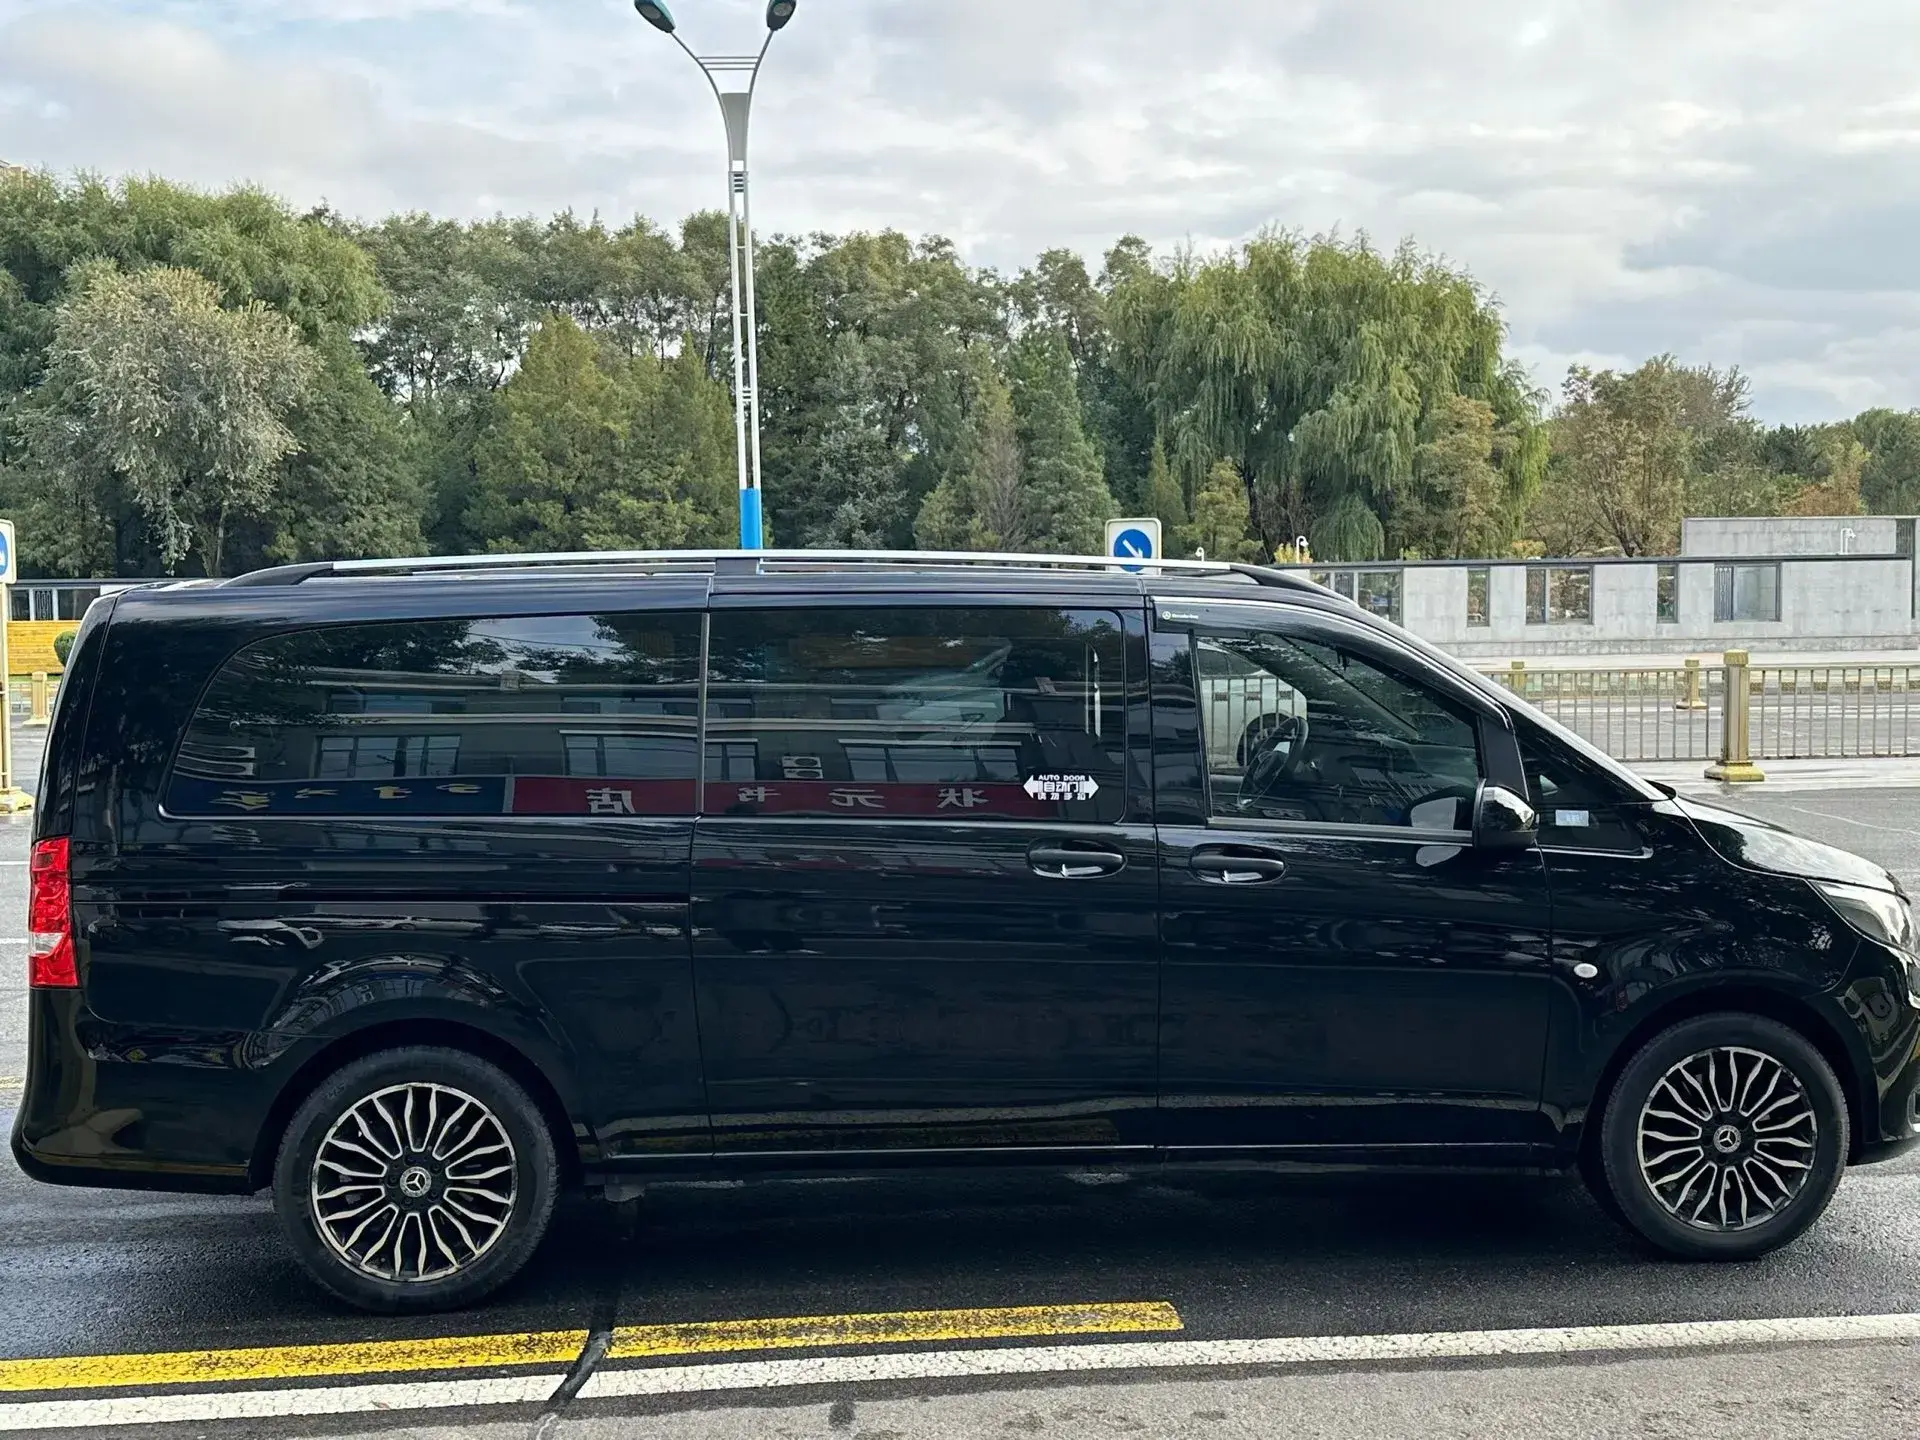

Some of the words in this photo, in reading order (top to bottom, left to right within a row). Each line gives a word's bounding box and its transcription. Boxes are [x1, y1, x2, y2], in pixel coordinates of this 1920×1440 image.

[1063, 774, 1086, 782] DOOR
[1043, 780, 1079, 793] 自动门
